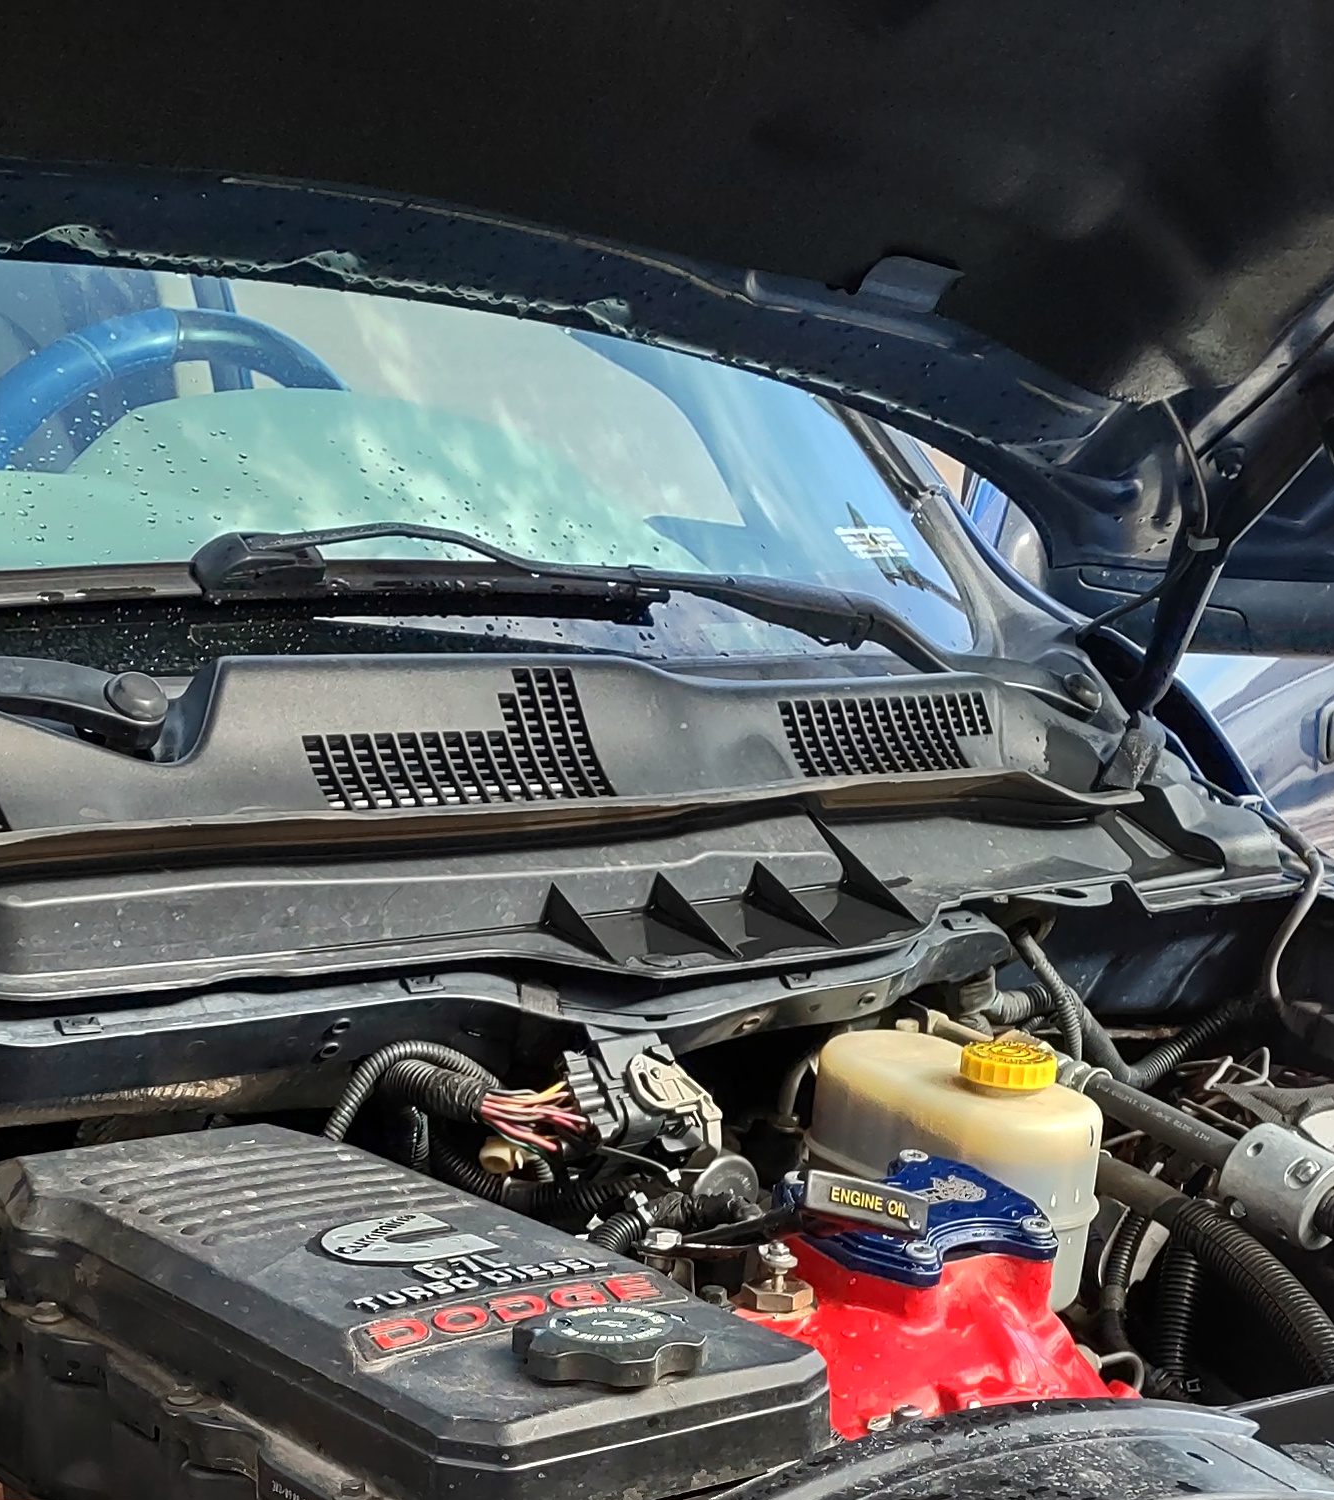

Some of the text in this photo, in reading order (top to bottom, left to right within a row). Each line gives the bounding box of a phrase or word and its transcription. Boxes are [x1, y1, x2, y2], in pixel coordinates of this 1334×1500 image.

[830, 1187, 910, 1219] ENGINE OIL
[334, 1215, 416, 1254] Cummins
[353, 1257, 609, 1313] TURBO DIESEL
[412, 1254, 510, 1281] 6.7L
[366, 1274, 663, 1351] DODGE
